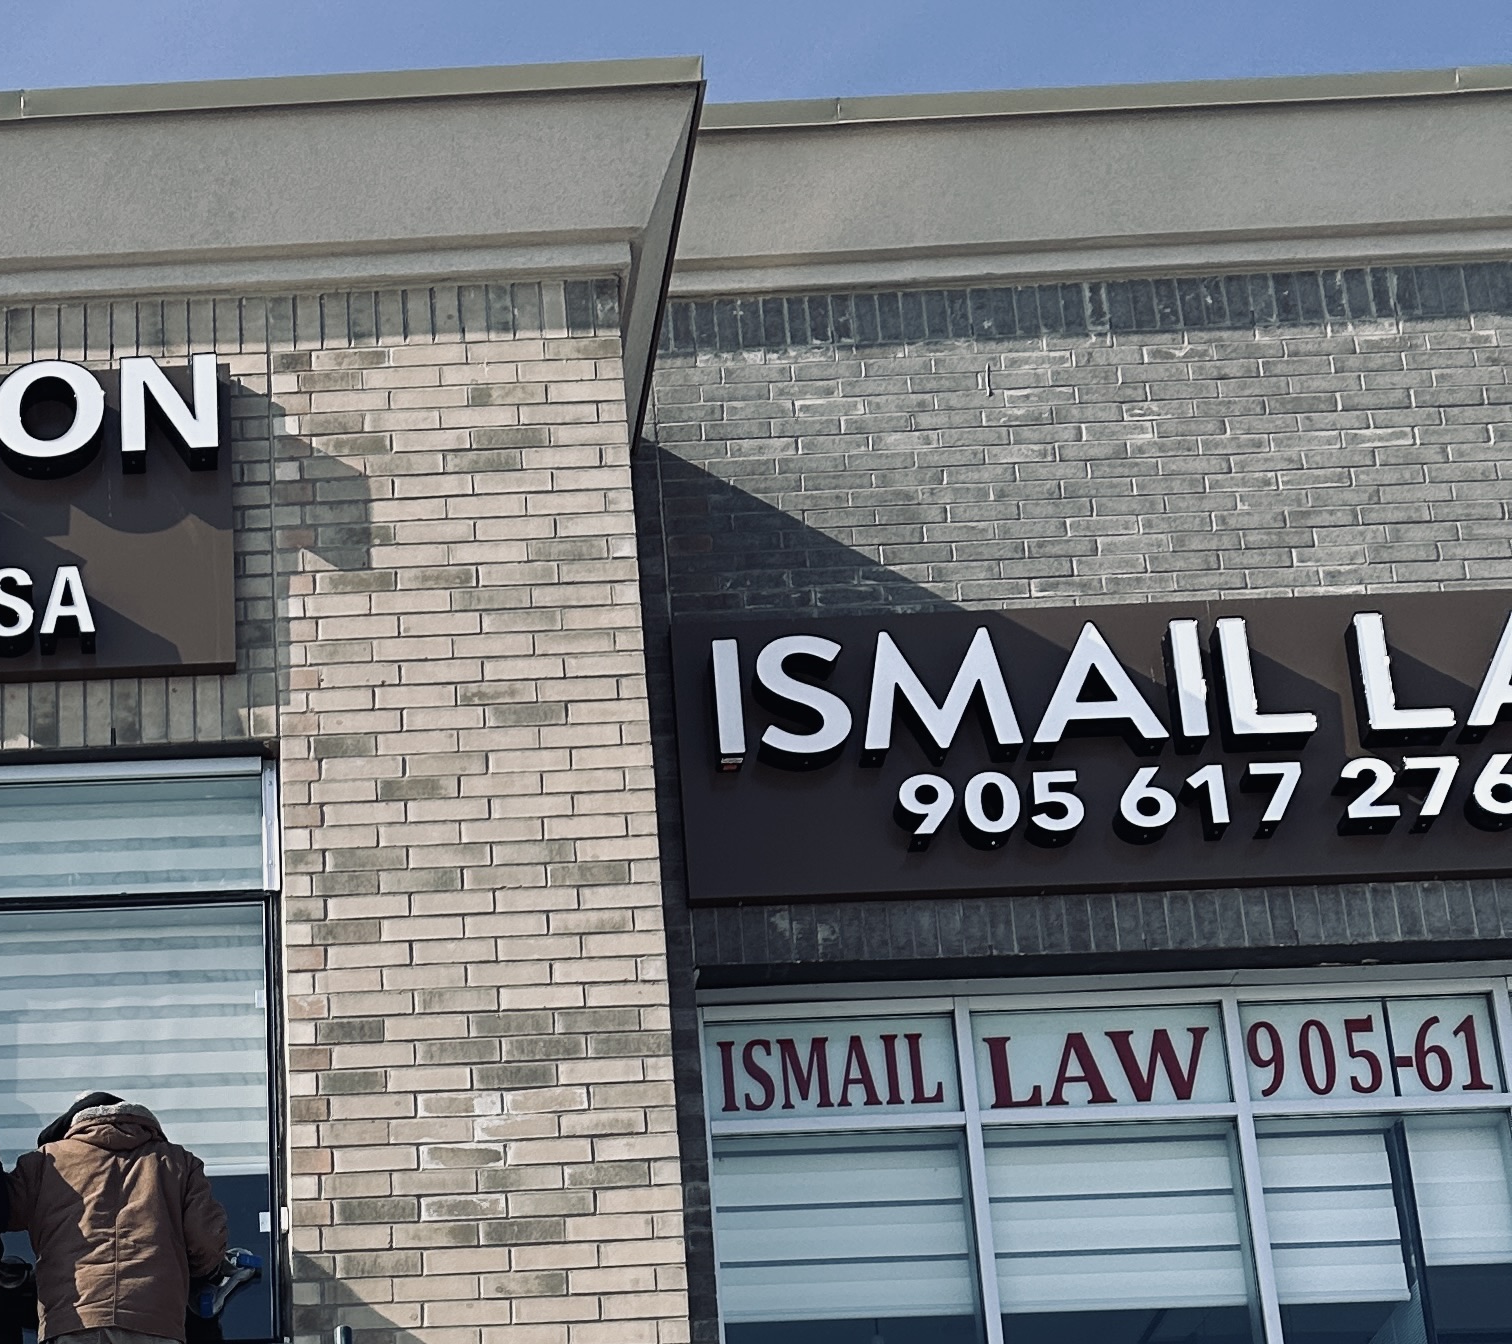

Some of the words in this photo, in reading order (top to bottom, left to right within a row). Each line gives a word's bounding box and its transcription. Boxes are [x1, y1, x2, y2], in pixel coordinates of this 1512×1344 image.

[711, 617, 1317, 754] ISMAIL
[898, 769, 1085, 835] 905
[1119, 761, 1302, 829] 617
[717, 1032, 944, 1112] ISMAIL
[982, 1026, 1209, 1109] LAW
